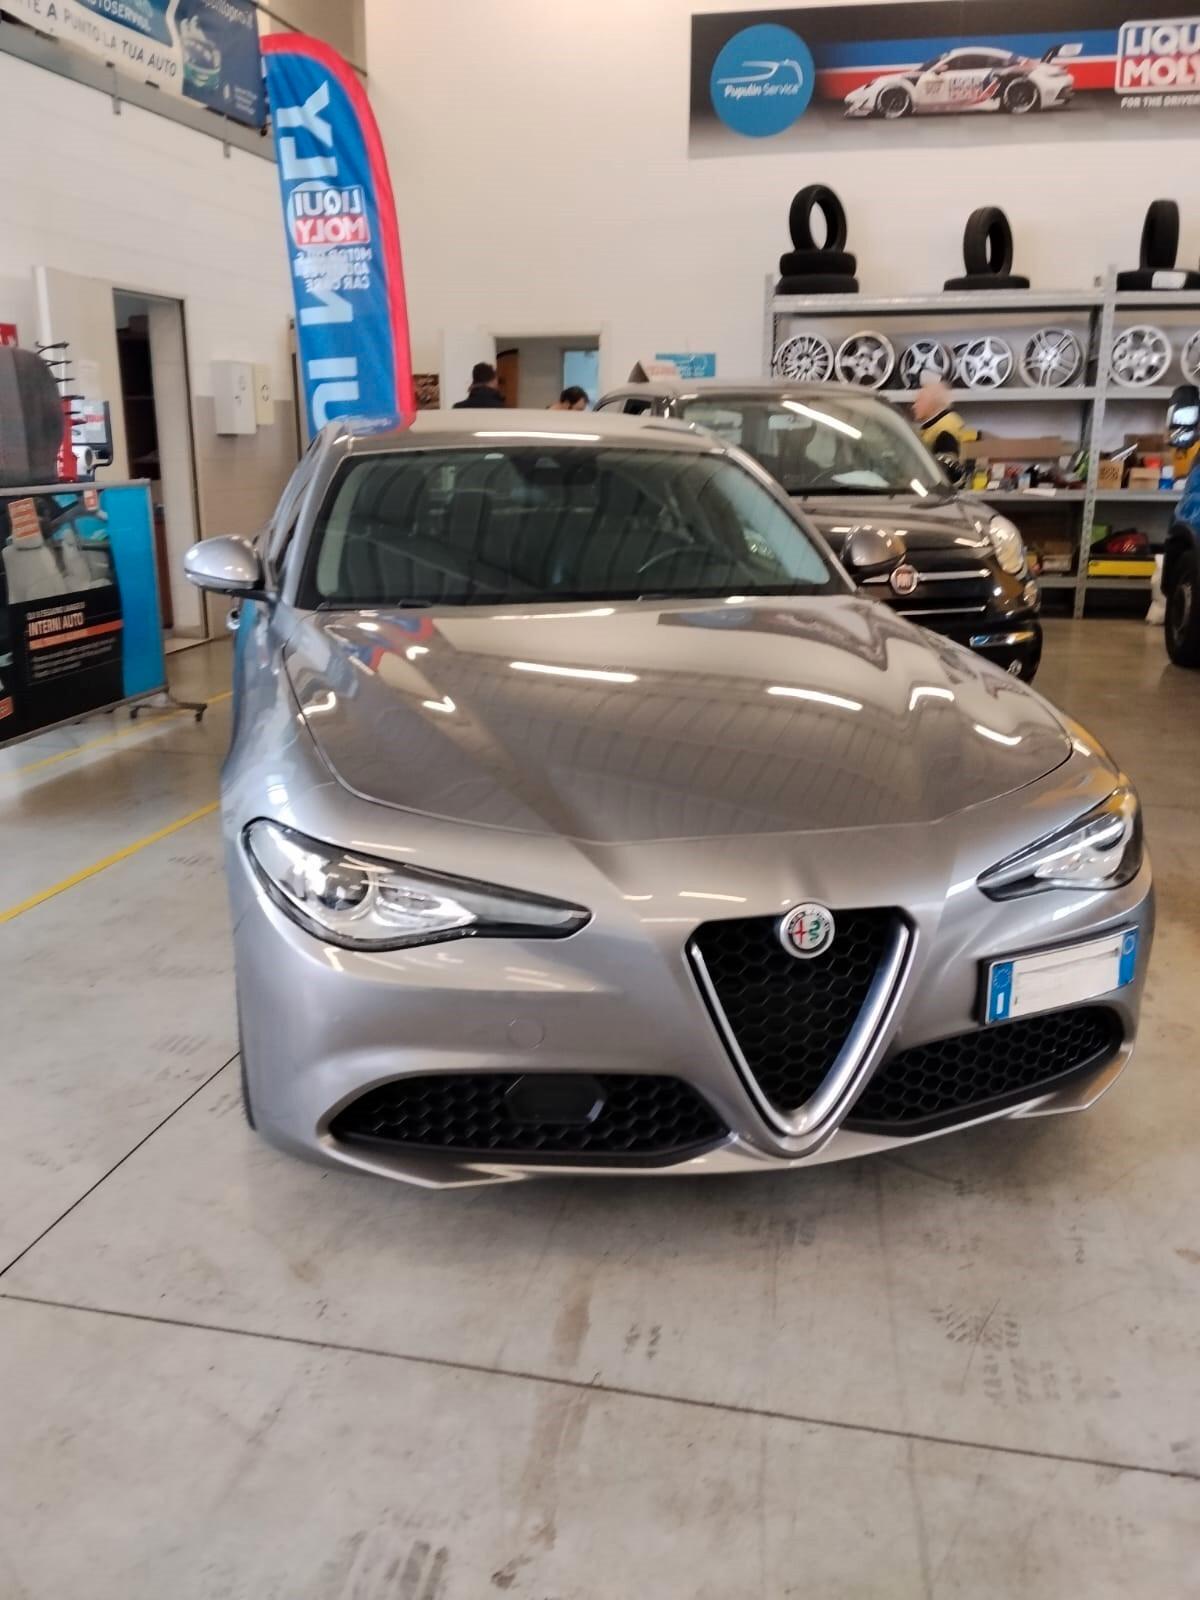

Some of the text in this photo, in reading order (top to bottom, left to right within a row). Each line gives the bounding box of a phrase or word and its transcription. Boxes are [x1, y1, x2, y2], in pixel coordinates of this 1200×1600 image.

[47, 3, 58, 21] A
[63, 8, 100, 42] PUNTO
[103, 31, 117, 49] LA
[121, 39, 145, 63] TUA
[147, 54, 178, 78] AUTO
[1121, 96, 1141, 109] FOR
[1143, 95, 1163, 108] THE
[28, 616, 62, 637] INTERNI
[62, 611, 85, 631] AUTO
